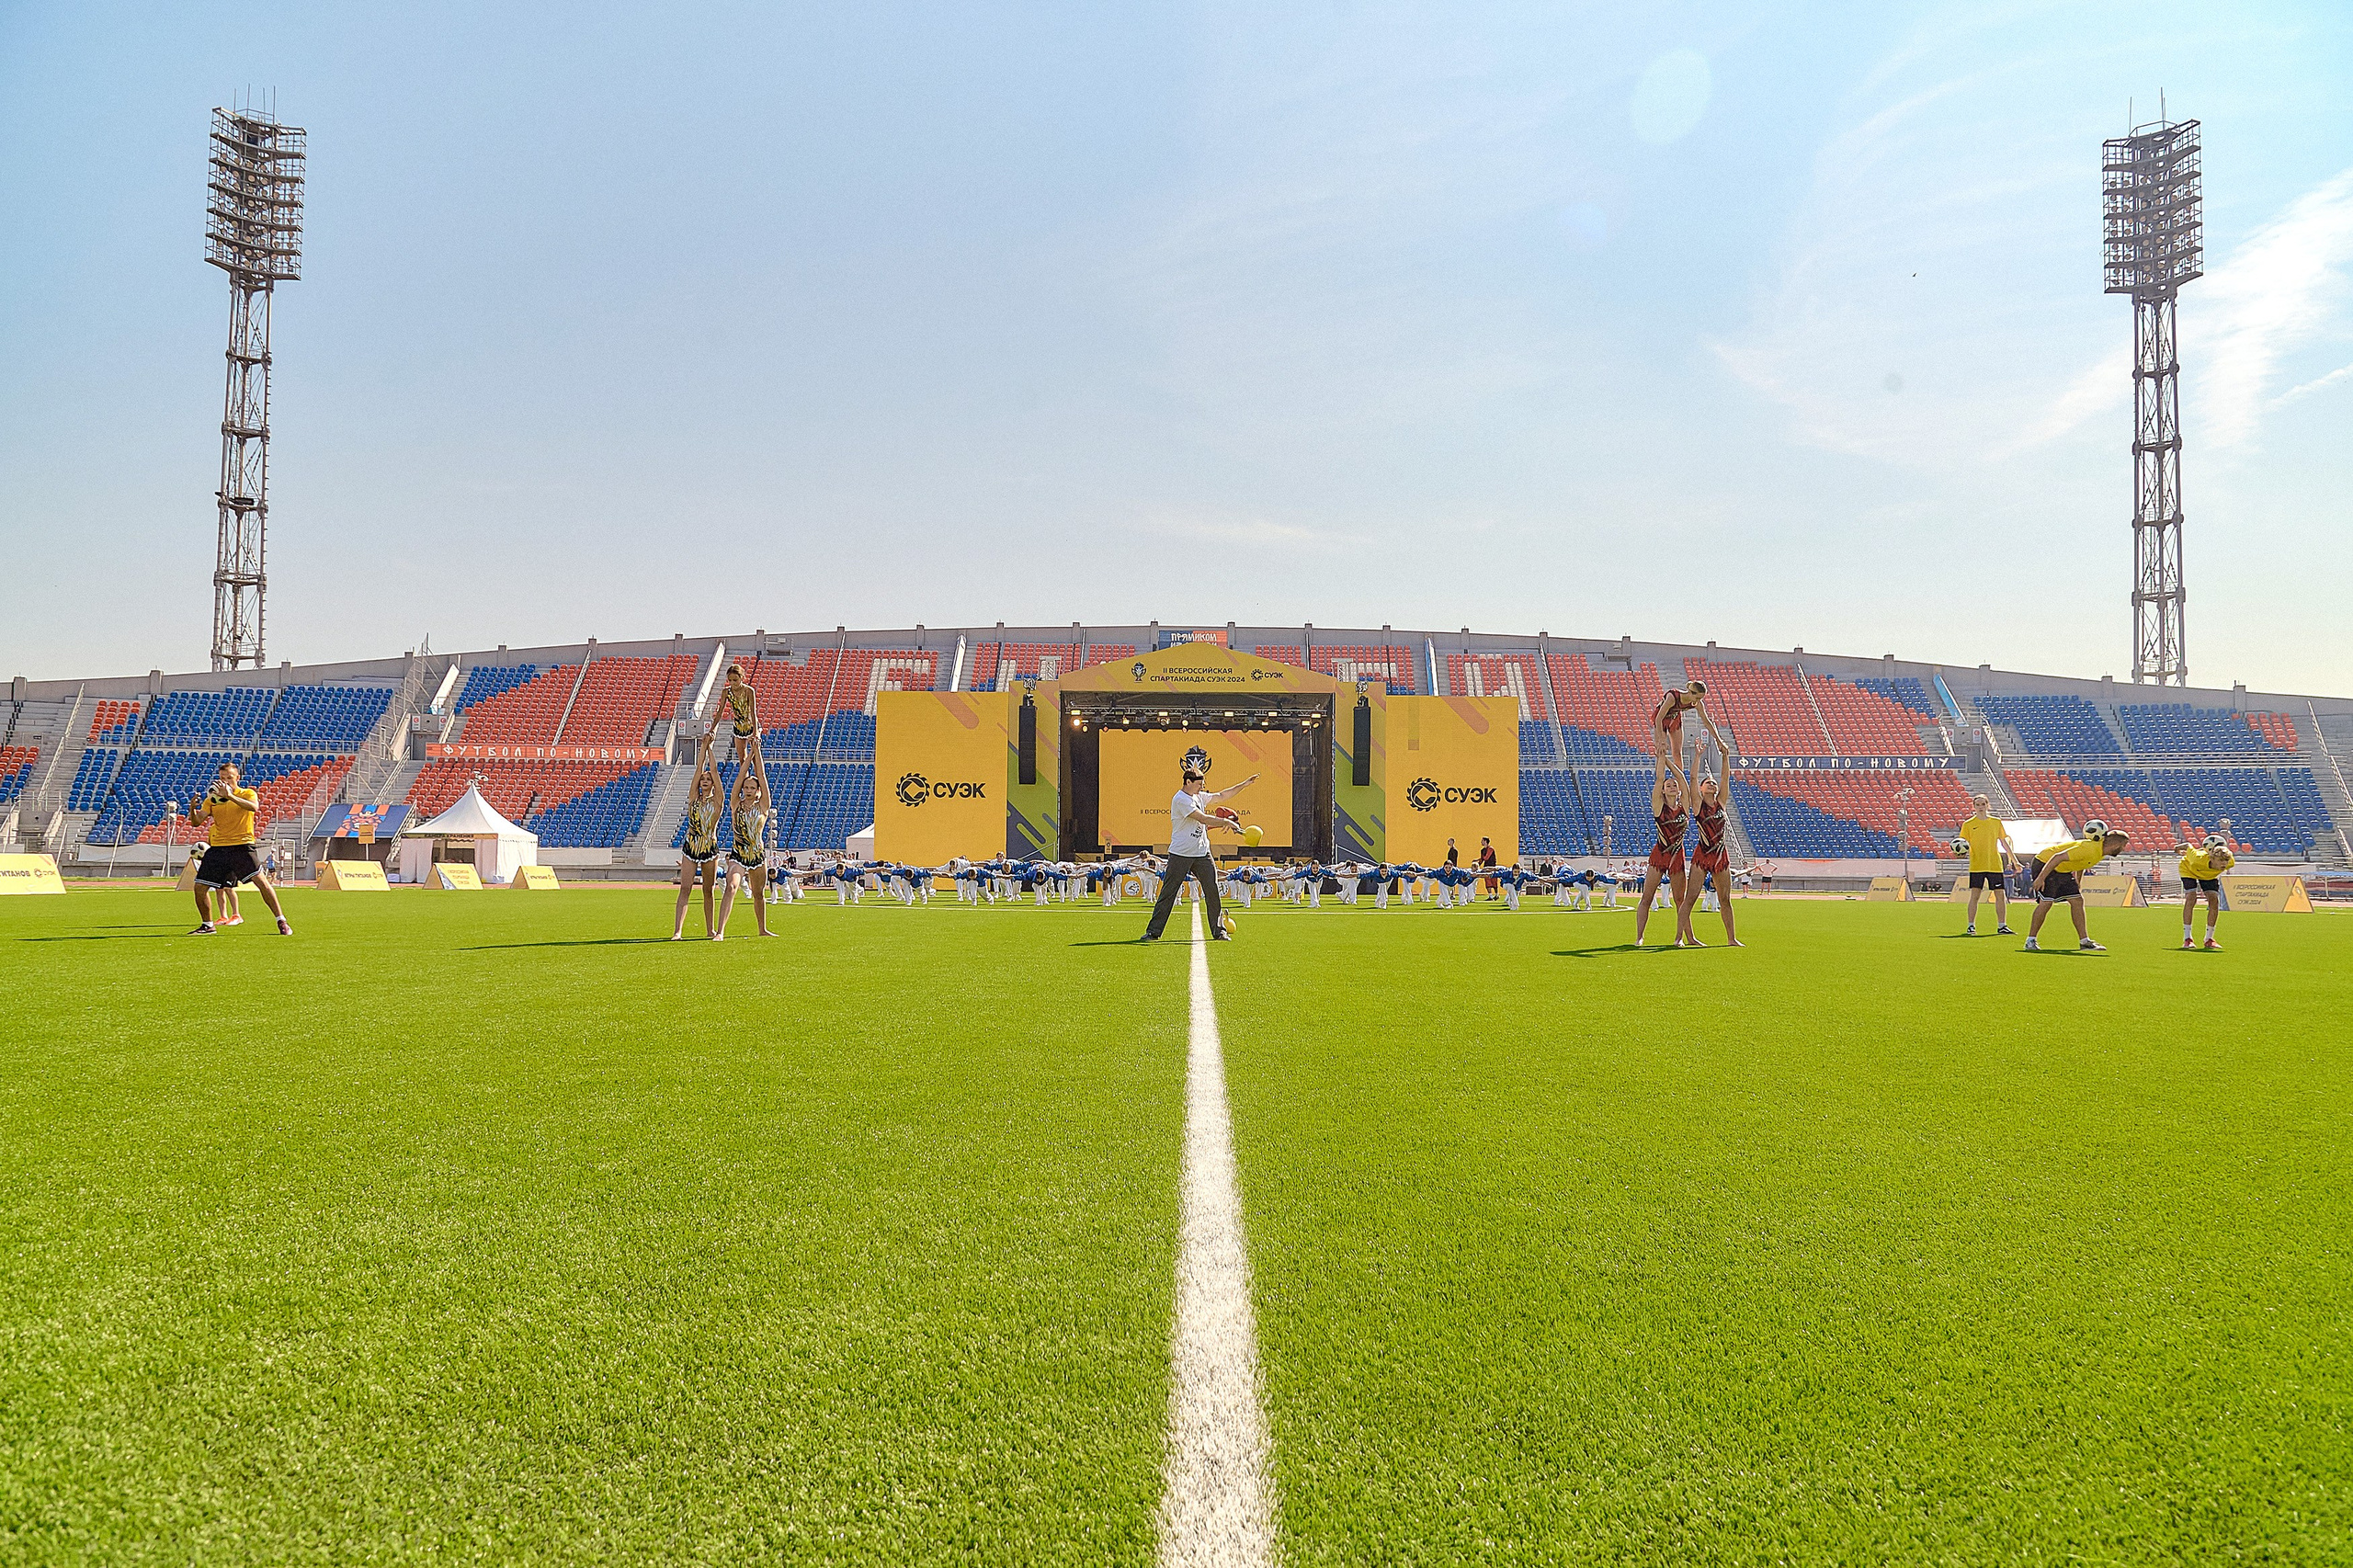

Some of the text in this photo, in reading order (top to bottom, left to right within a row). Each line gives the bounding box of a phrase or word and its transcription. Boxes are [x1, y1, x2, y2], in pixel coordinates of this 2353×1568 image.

[1171, 632, 1217, 642] ПРЯМИКОМ
[1169, 666, 1233, 675] ВСЕРОССИЙСКАЯ
[1150, 675, 1206, 683] СПАРТАКИАДА
[443, 744, 522, 756] ФУТБОЛ
[1738, 756, 1817, 768] ФУТБОЛ
[933, 782, 986, 799] СУЭК
[1444, 787, 1498, 803] СУЭК
